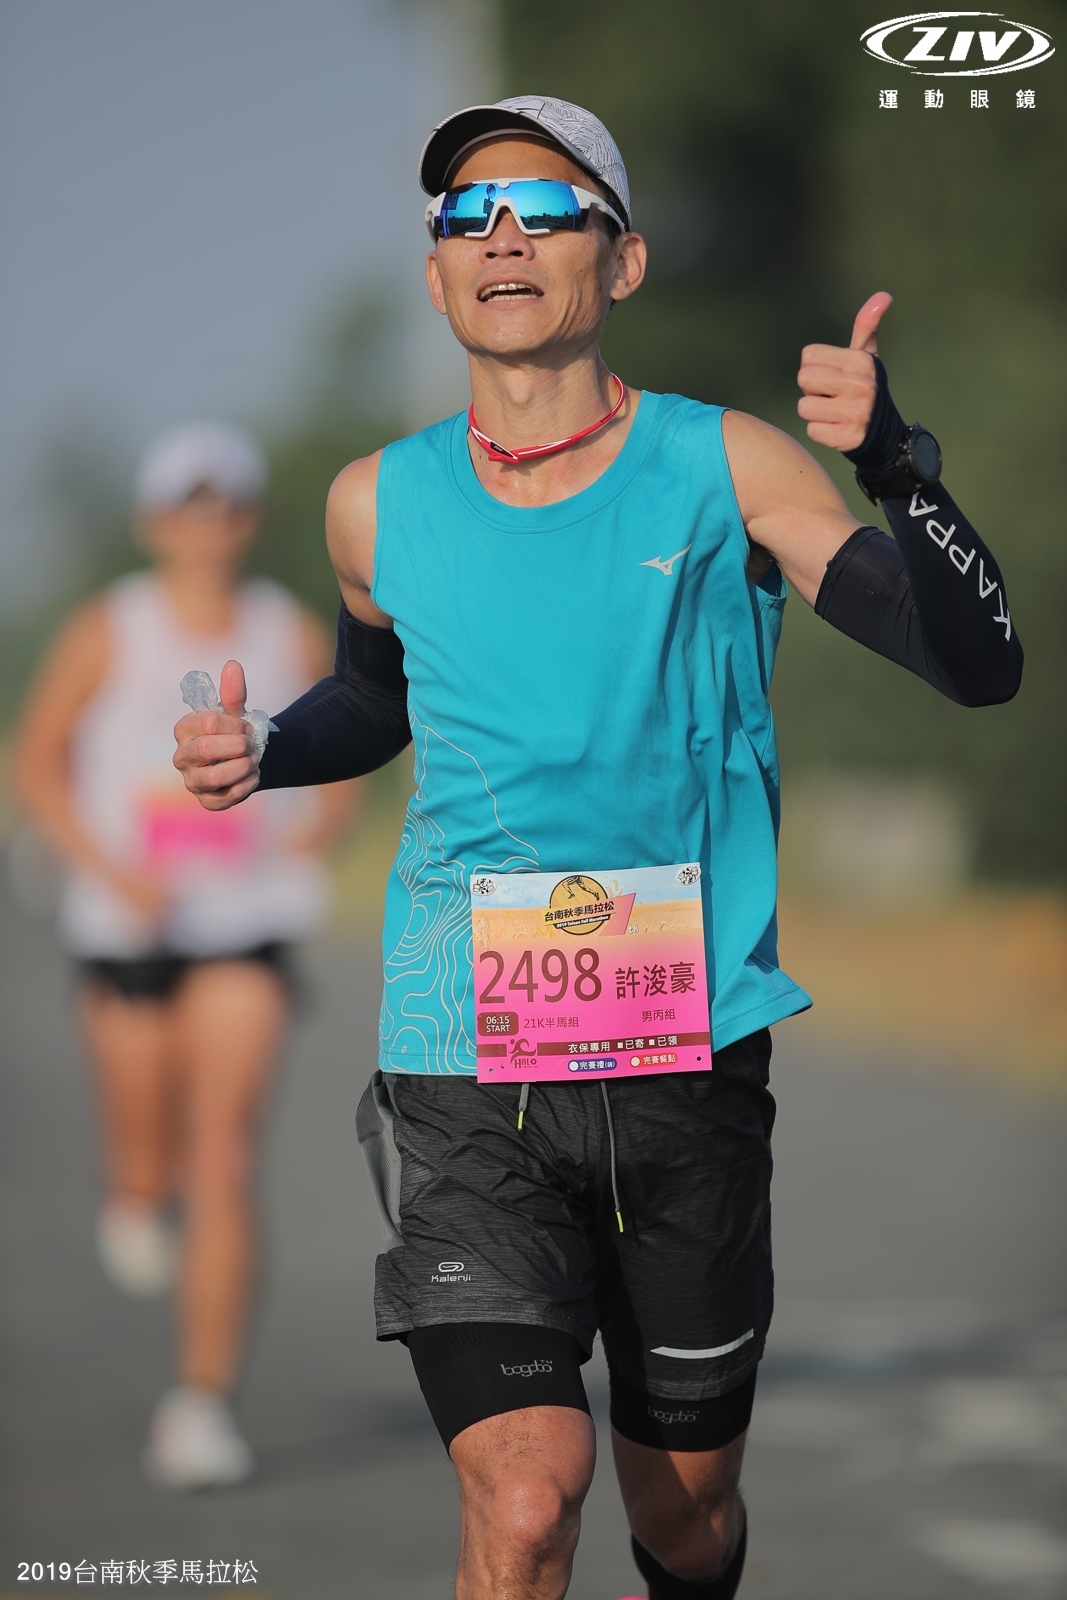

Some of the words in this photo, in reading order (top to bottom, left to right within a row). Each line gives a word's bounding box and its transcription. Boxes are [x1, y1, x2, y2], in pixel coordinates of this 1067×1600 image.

[908, 492, 1011, 641] KAPPA
[544, 900, 615, 922] 台南秋季馬拉松
[479, 947, 602, 1004] 2498
[615, 961, 696, 1000] 許浚豪
[486, 1015, 510, 1025] 06:15
[641, 1008, 676, 1023] 男丙組
[486, 1024, 511, 1033] START
[523, 1016, 579, 1029] 21K半馬組
[568, 1041, 611, 1054] 衣保專用
[643, 1053, 676, 1065] 完賽餐點
[431, 1273, 471, 1283] Kalenji
